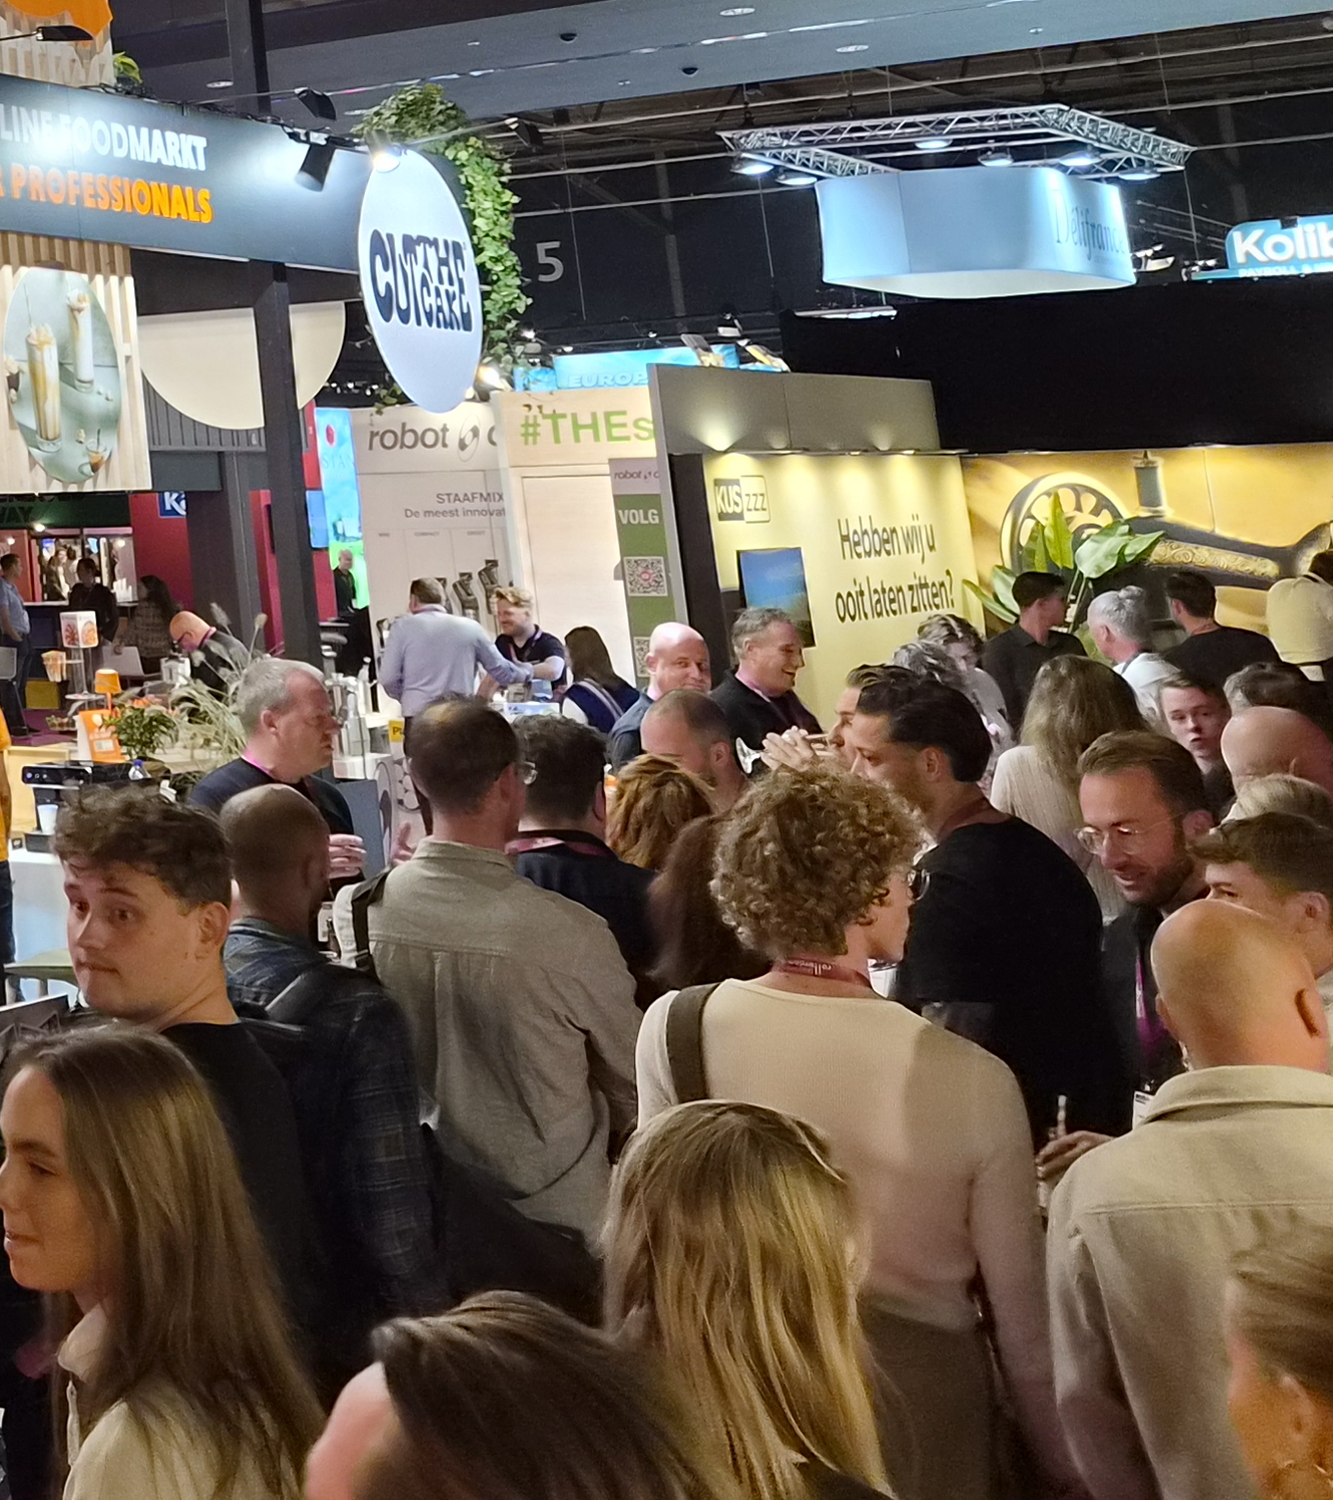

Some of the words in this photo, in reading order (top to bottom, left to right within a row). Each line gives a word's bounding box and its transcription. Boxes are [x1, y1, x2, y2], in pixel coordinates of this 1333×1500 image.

[59, 113, 208, 172] FOODMARKT
[10, 163, 214, 224] PROFESSIONALS
[536, 241, 564, 283] 5
[368, 420, 450, 451] robot
[404, 508, 420, 519] De
[423, 508, 460, 518] meest
[618, 507, 660, 526] VOLG
[715, 483, 743, 515] KUS
[837, 515, 900, 561] Hebben
[901, 513, 926, 565] wij
[926, 523, 937, 553] u
[835, 580, 867, 624] ooit
[868, 575, 909, 620] laten
[909, 569, 956, 613] zitten?
